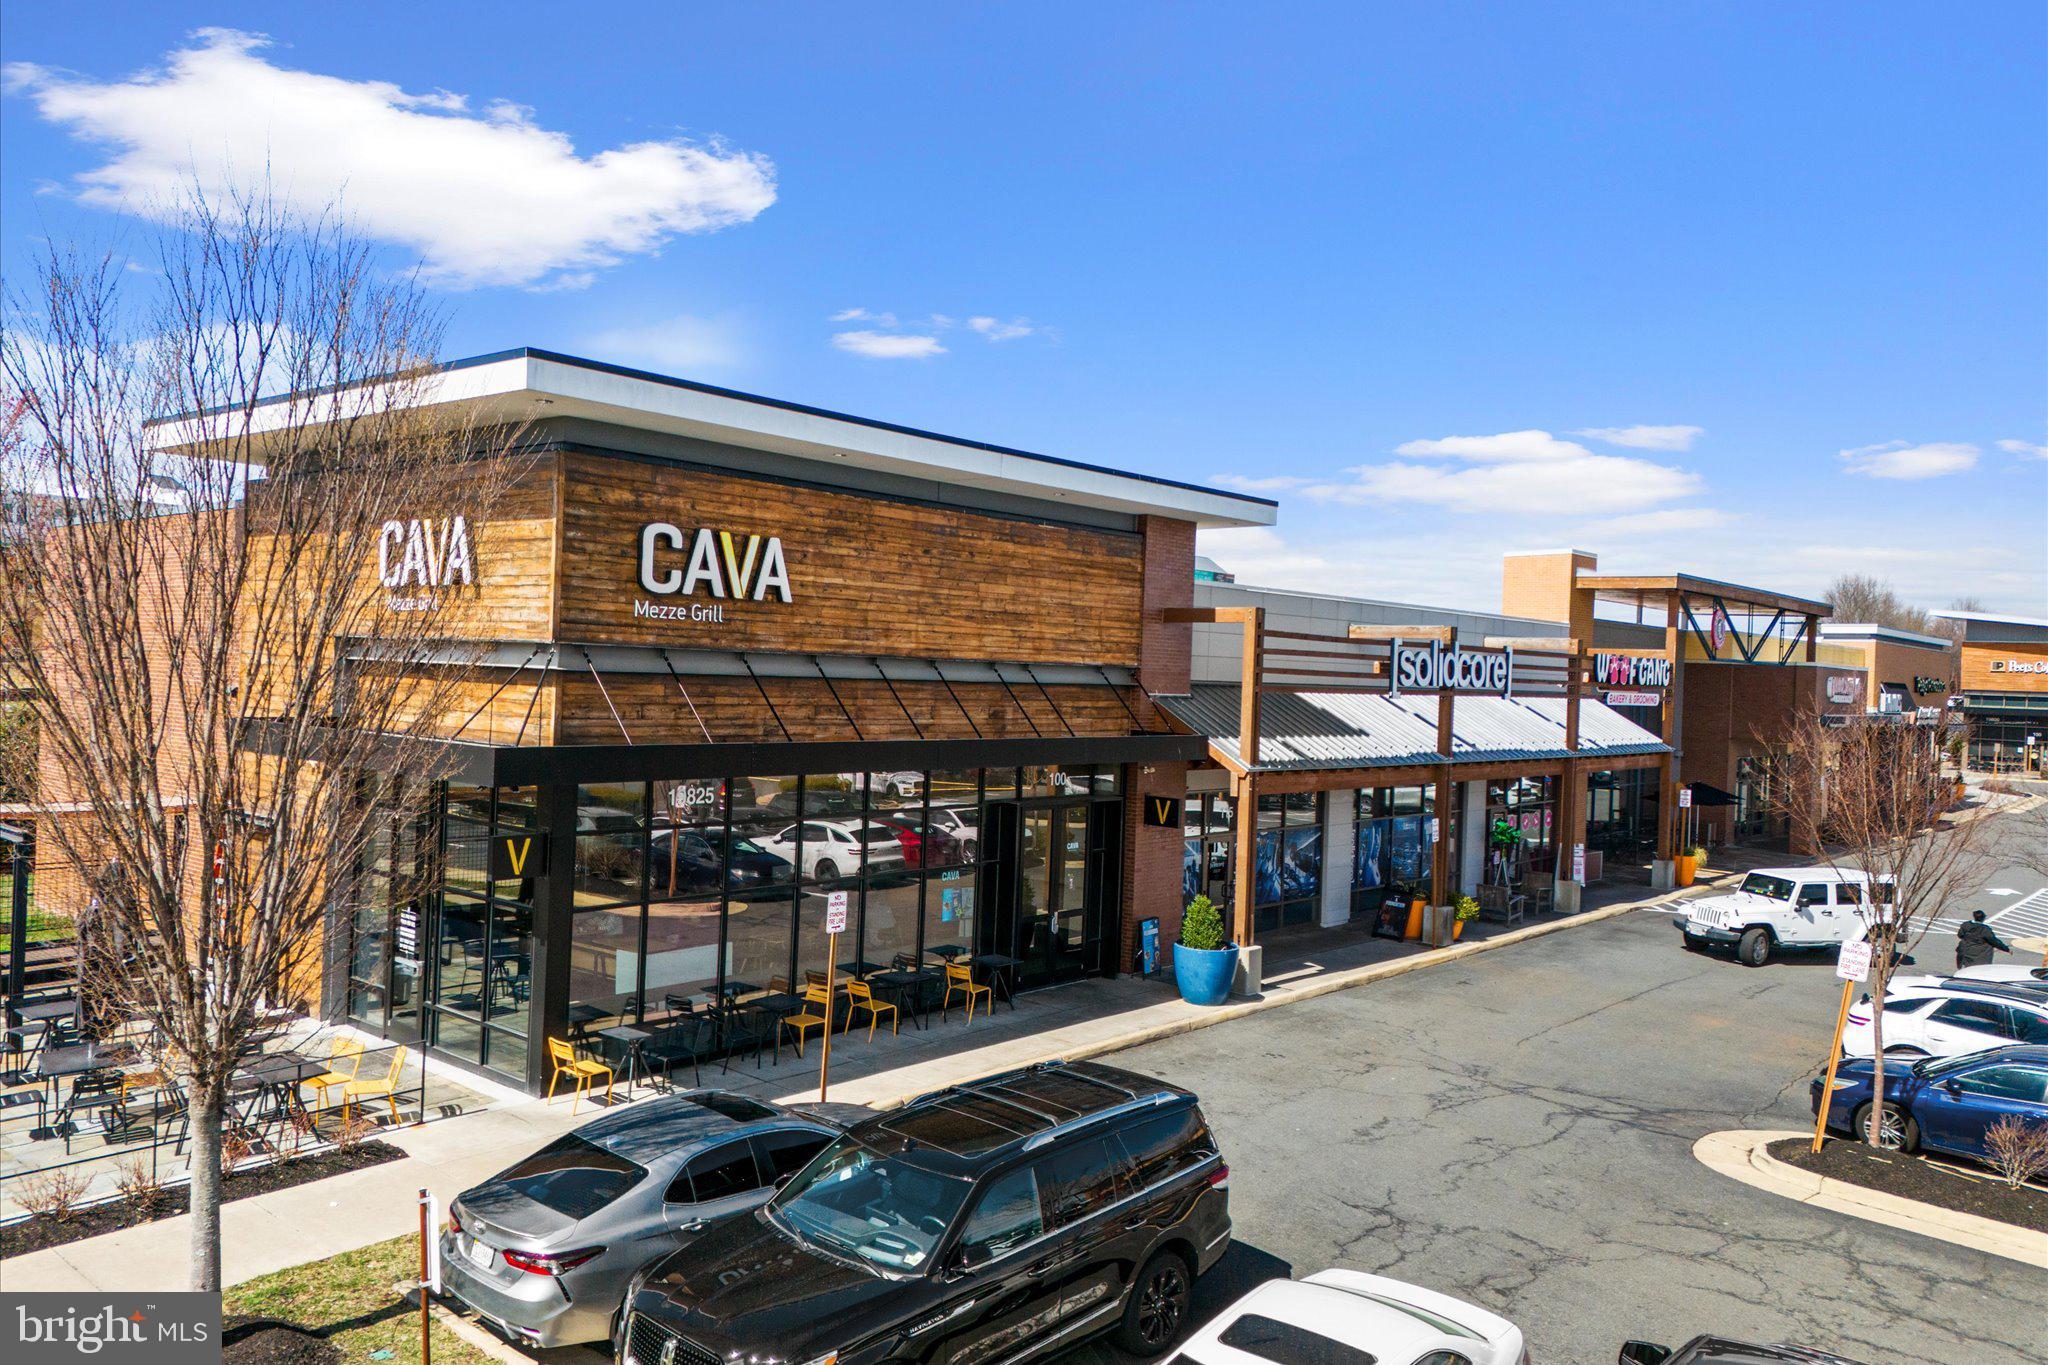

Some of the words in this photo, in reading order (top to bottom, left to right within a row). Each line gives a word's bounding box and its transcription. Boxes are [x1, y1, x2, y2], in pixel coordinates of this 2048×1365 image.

[379, 515, 472, 587] CAVA
[638, 522, 793, 604] CAVA
[634, 599, 687, 621] Mezze
[691, 604, 723, 623] Grill
[1609, 693, 1628, 704] BAKERY
[1049, 772, 1067, 786] 100
[668, 787, 715, 805] 1825
[507, 838, 531, 875] V
[942, 871, 960, 881] CAVA
